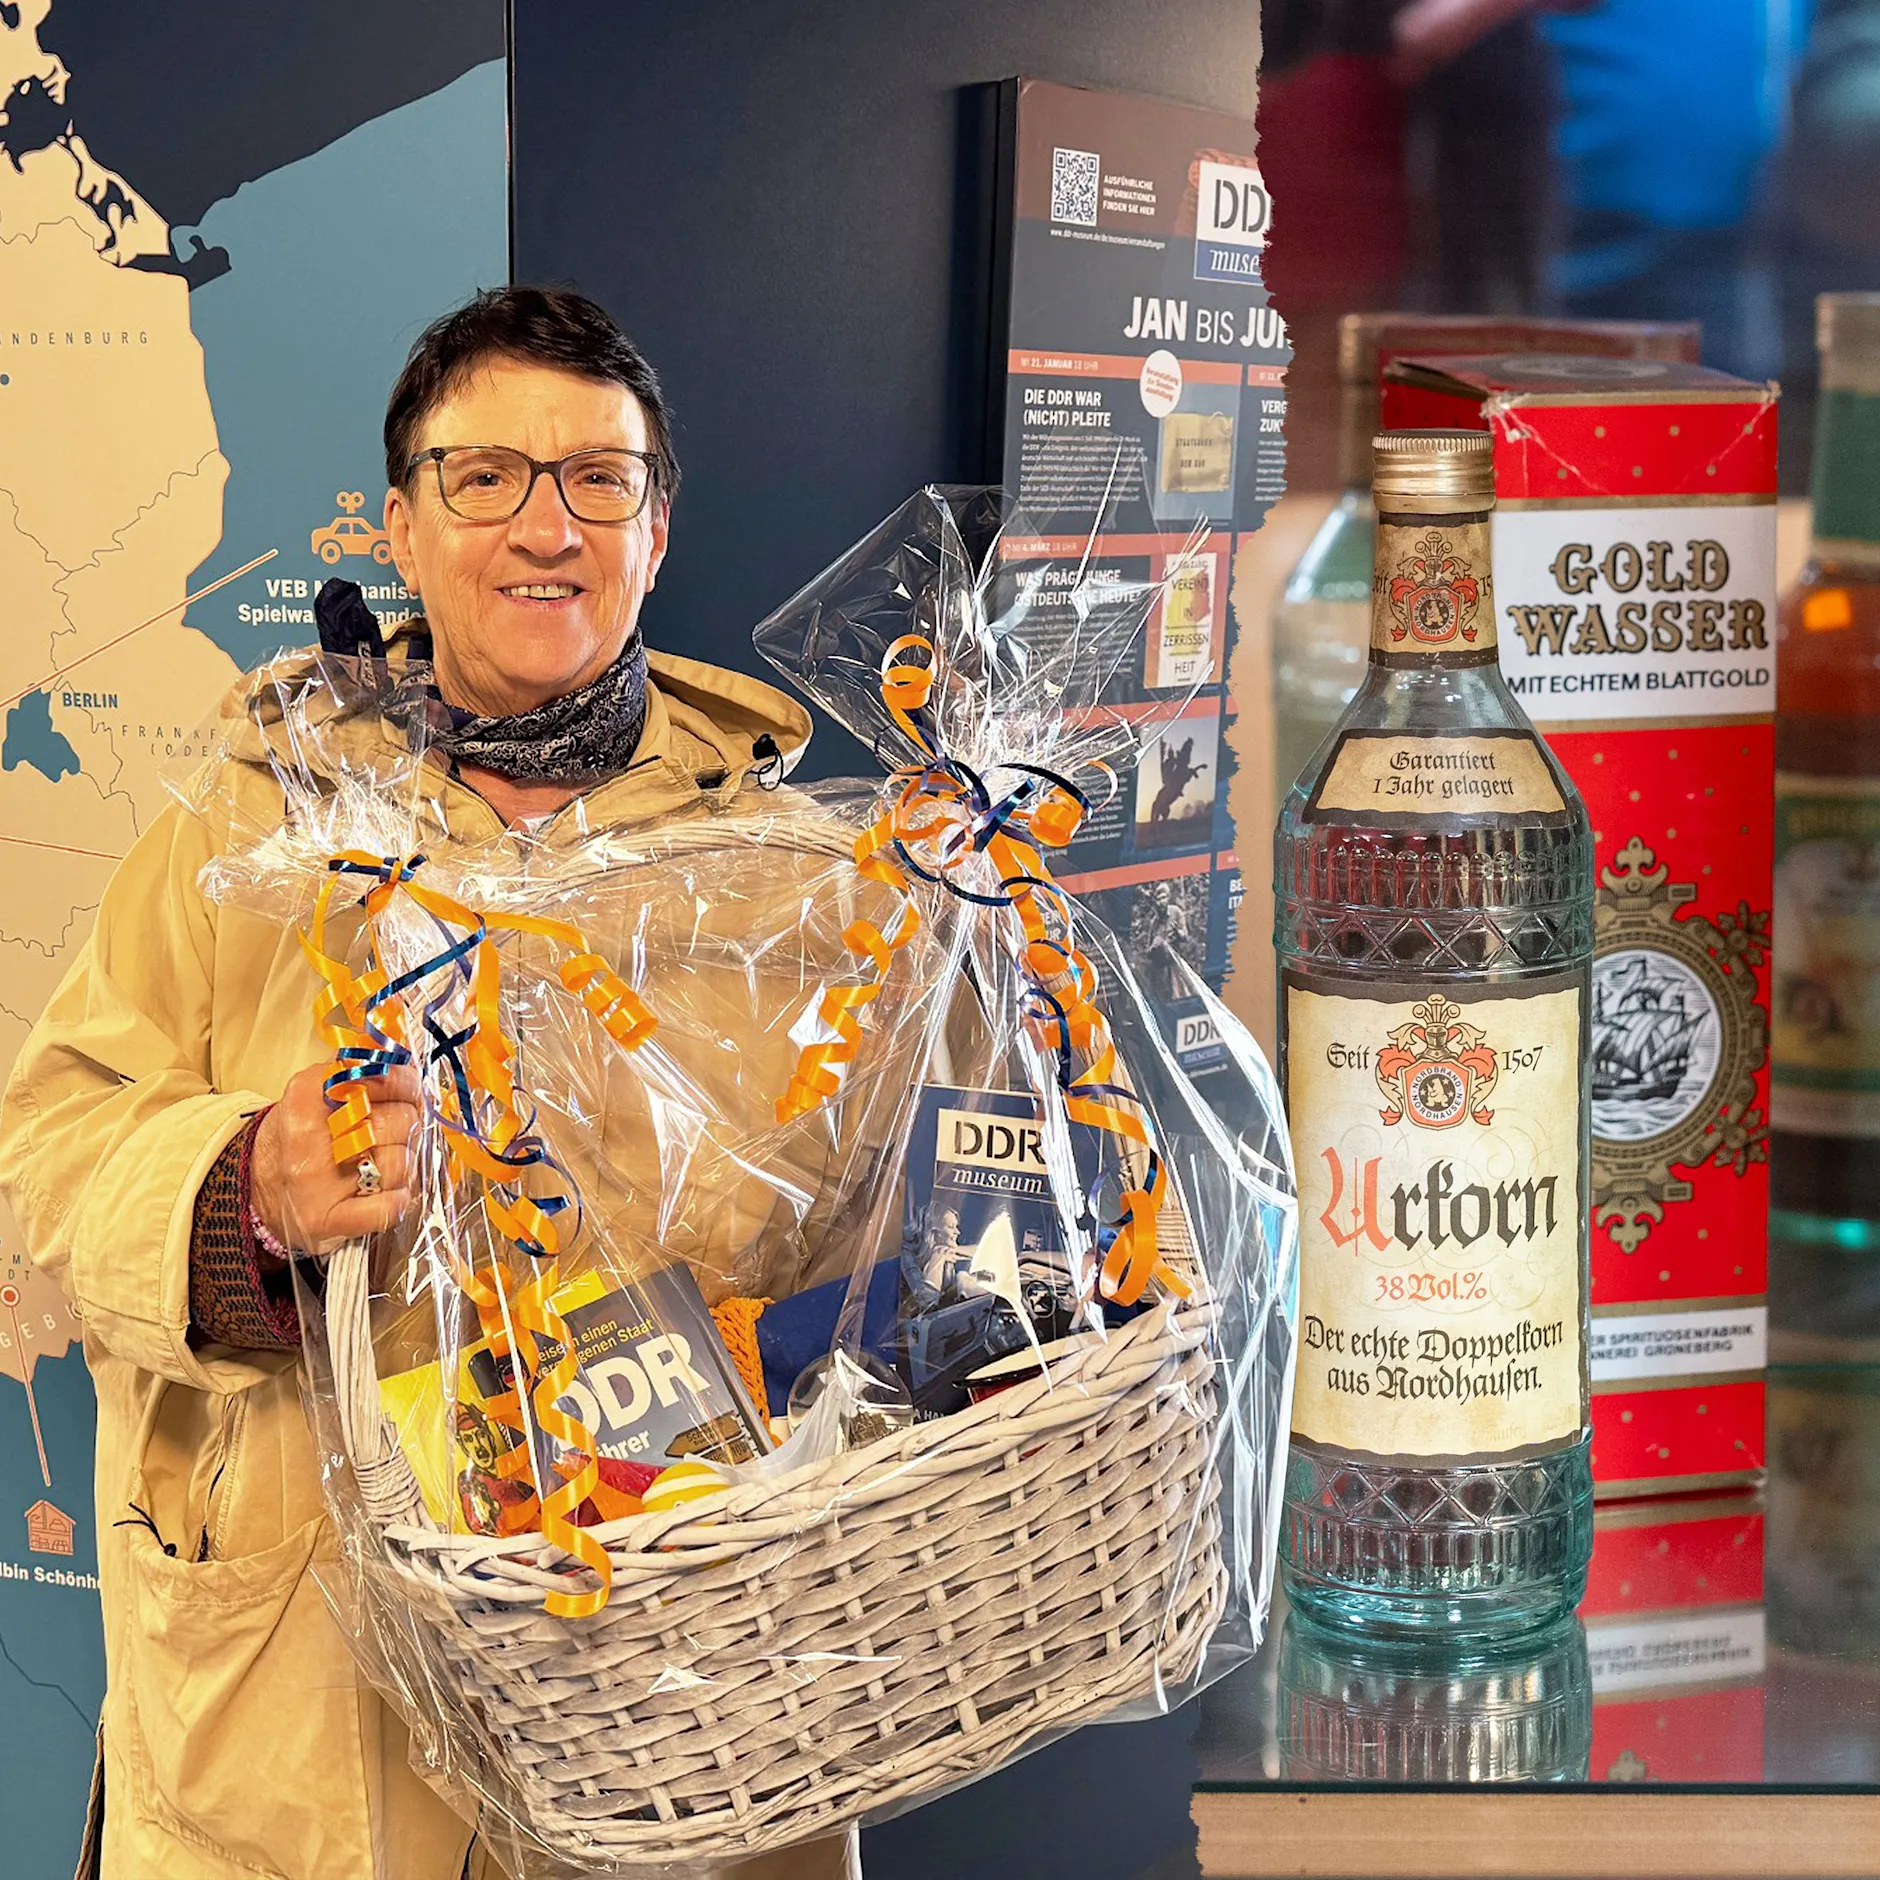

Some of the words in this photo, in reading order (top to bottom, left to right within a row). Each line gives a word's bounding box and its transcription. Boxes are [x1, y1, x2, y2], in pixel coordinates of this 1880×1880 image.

[1123, 296, 1188, 342] JAN
[1195, 309, 1235, 346] BIS
[1043, 357, 1073, 370] JANUAR
[1024, 388, 1045, 405] DIE
[1047, 389, 1074, 406] DDR
[1075, 391, 1102, 407] WAR
[1023, 408, 1070, 427] (NICHT)
[1071, 410, 1112, 428] PLEITE
[1548, 538, 1731, 595] GOLD
[265, 578, 309, 598] VEB
[1015, 571, 1043, 587] WAS
[1414, 614, 1455, 636] NORDHAUSEN
[1505, 598, 1770, 657] WASSER
[1163, 634, 1209, 648] ZERRISSEN
[1174, 660, 1196, 674] HEIT
[1507, 675, 1546, 696] MIT
[1550, 673, 1641, 694] ECHTEM
[1646, 668, 1770, 691] BLATTGOLD
[62, 692, 118, 709] BERLIN
[1389, 750, 1496, 772] Garantiert
[1382, 775, 1434, 799] Jahr
[1441, 775, 1514, 799] gelagert
[1326, 1042, 1371, 1071] Seit
[1501, 1044, 1545, 1074] 1507
[1412, 1066, 1462, 1089] NORDBRAND
[1411, 1092, 1463, 1120] NORDHAUSEN
[953, 1119, 1047, 1166] DDR
[951, 1167, 1046, 1195] museum
[1319, 1146, 1559, 1258] Urkorn
[580, 1319, 619, 1344] einen
[617, 1317, 655, 1343] Staat
[1304, 1315, 1344, 1354] Der
[1350, 1324, 1410, 1366] echte
[1416, 1316, 1564, 1367] Doppelkorn
[1609, 1324, 1754, 1346] SPIRITUOSENFABRIK
[1327, 1367, 1371, 1397] aus
